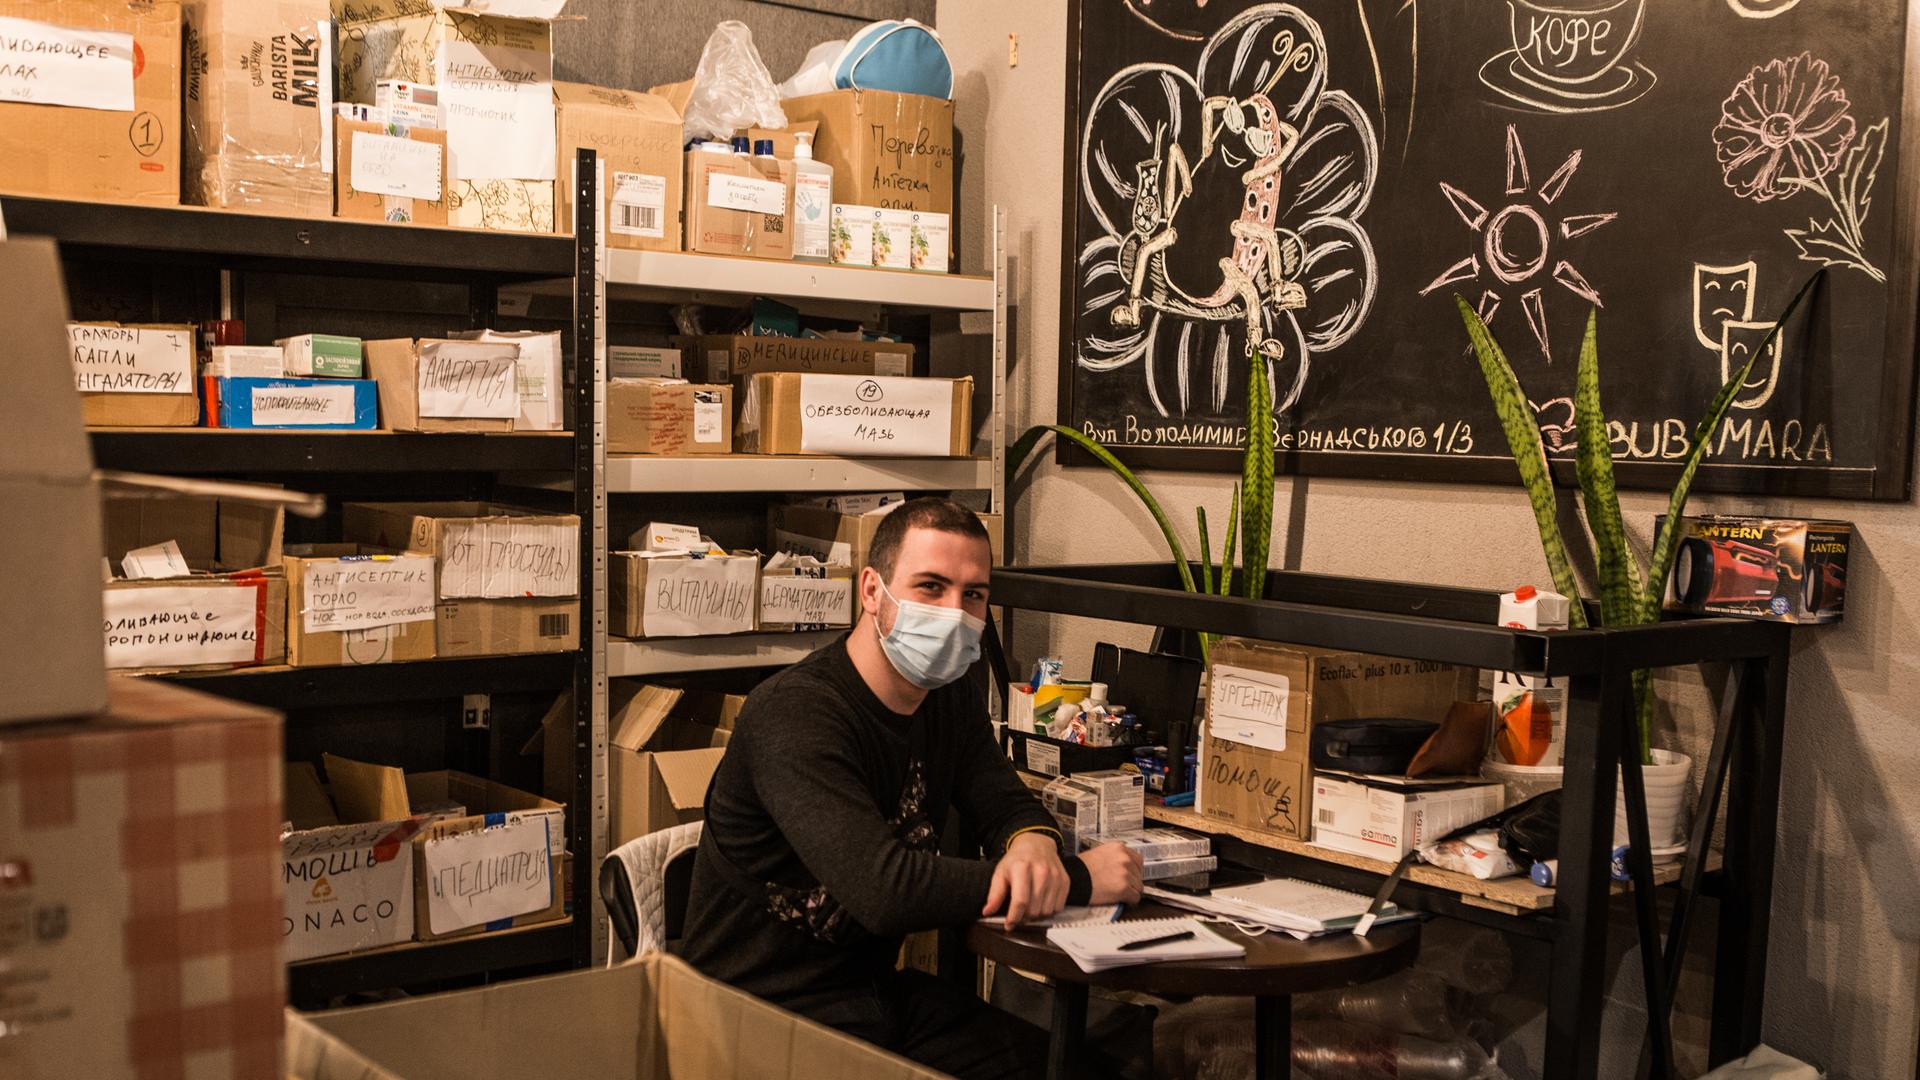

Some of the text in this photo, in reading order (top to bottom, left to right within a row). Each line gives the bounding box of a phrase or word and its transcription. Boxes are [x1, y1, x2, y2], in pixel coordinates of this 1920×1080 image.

[272, 35, 287, 101] BARISTA
[290, 32, 319, 108] MILK
[448, 62, 538, 83] АНТИБИОТИК
[68, 327, 140, 344] ГАЛЯТОРЫ
[74, 345, 136, 368] КАПЛИ
[76, 371, 182, 391] НГАЛЯТОРЫ
[805, 404, 931, 420] ОБЕЗБОЛИВАЮЩАЯ
[854, 424, 895, 441] МАЗЬ
[452, 540, 476, 566] ОТ
[1810, 543, 1847, 554] LANTERN
[313, 570, 427, 588] АНТИСЕПТИК
[313, 592, 357, 611] ГОРЛО
[657, 577, 752, 623] ВИТАМИНЫ
[313, 613, 337, 623] НОС
[1364, 664, 1386, 681] plus
